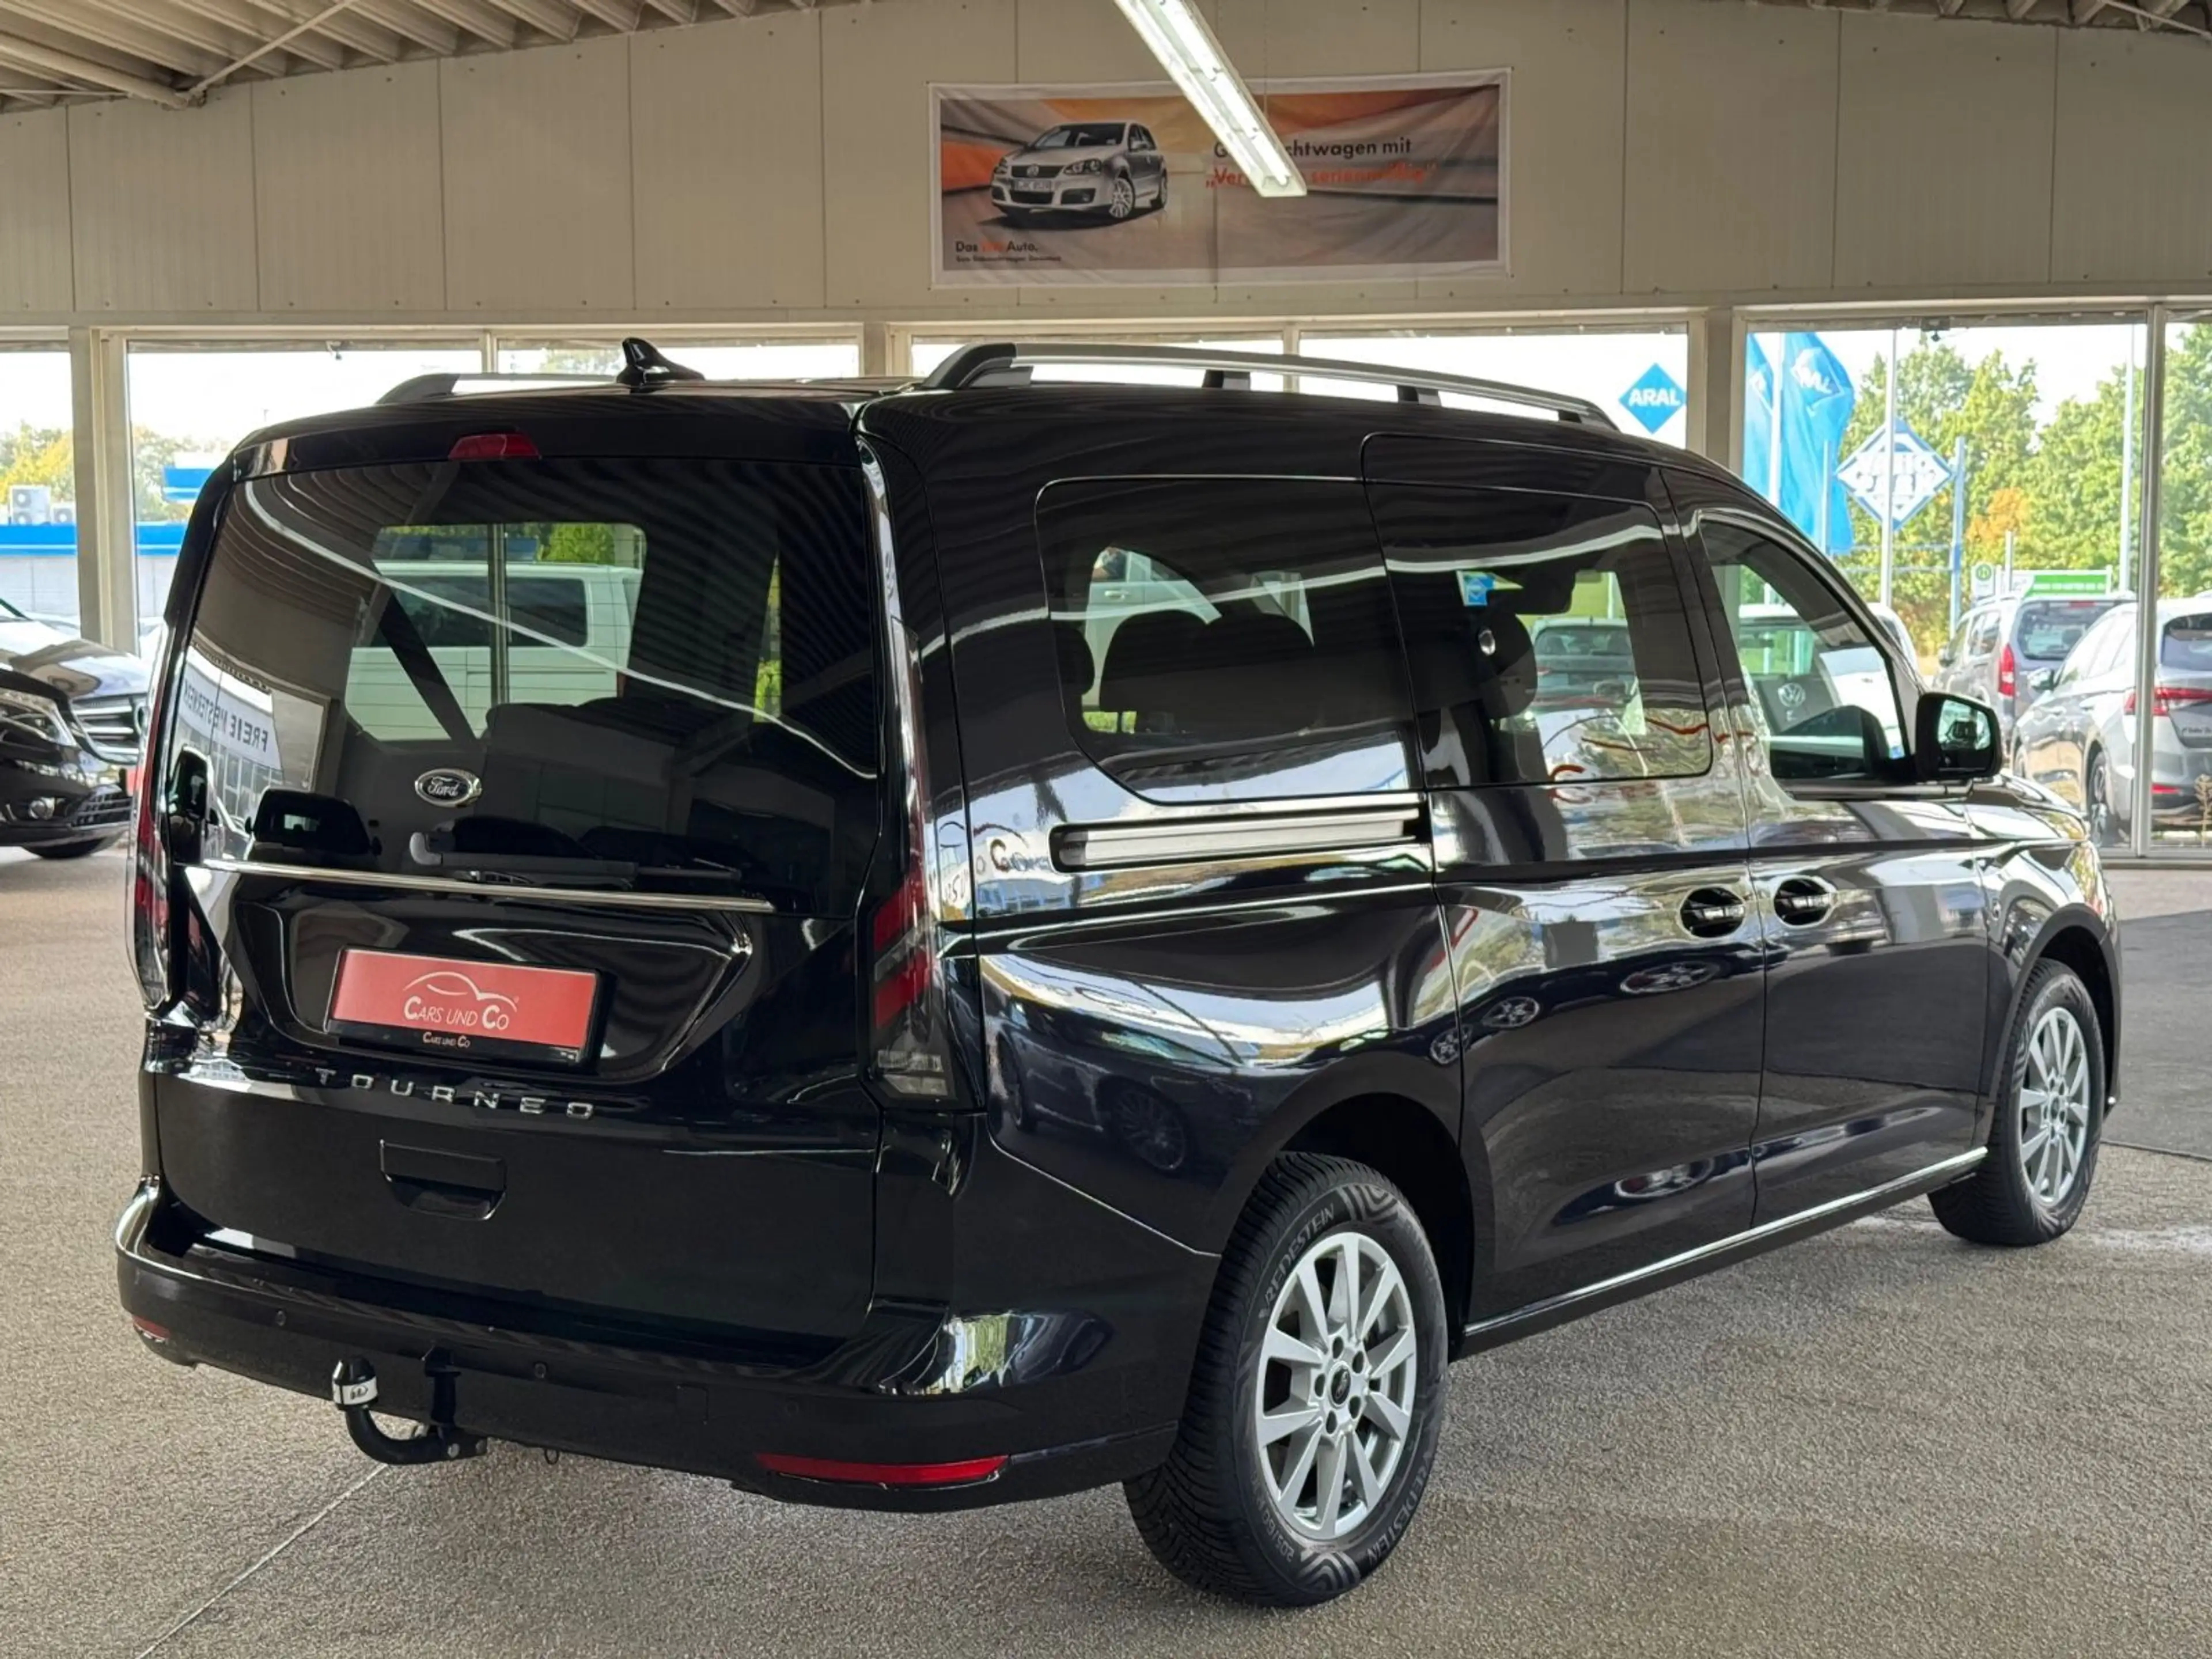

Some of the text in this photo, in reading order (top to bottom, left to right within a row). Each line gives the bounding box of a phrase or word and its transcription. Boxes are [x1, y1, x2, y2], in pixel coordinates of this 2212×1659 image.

[1214, 137, 1411, 160] Gchtwagen mit
[1628, 387, 1681, 407] ARAL
[427, 776, 461, 796] Ford
[315, 1067, 594, 1120] TOURNEO
